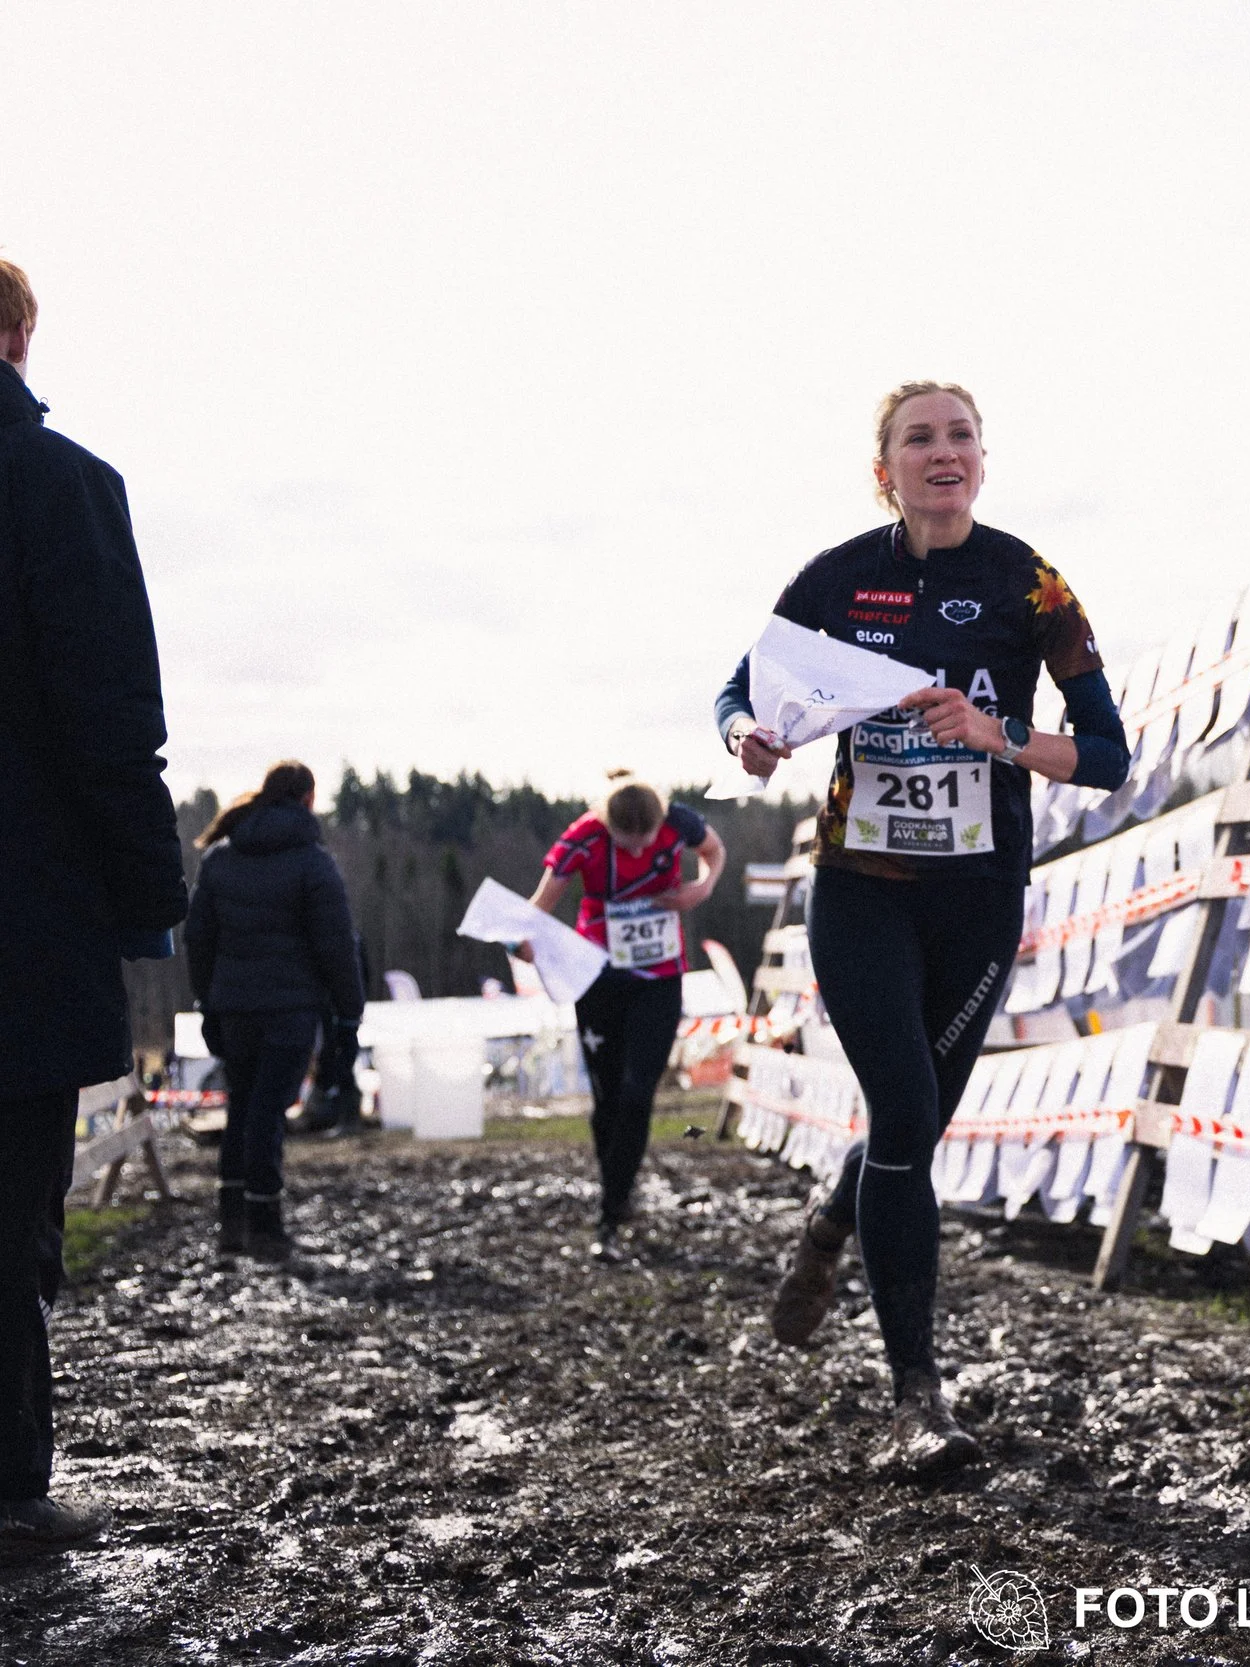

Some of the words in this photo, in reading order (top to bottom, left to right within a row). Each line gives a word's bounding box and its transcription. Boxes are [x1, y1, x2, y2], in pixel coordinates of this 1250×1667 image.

[847, 609, 911, 624] mercur
[970, 768, 980, 783] 1
[876, 771, 959, 811] 281
[622, 917, 667, 942] 267
[935, 961, 1000, 1057] noname
